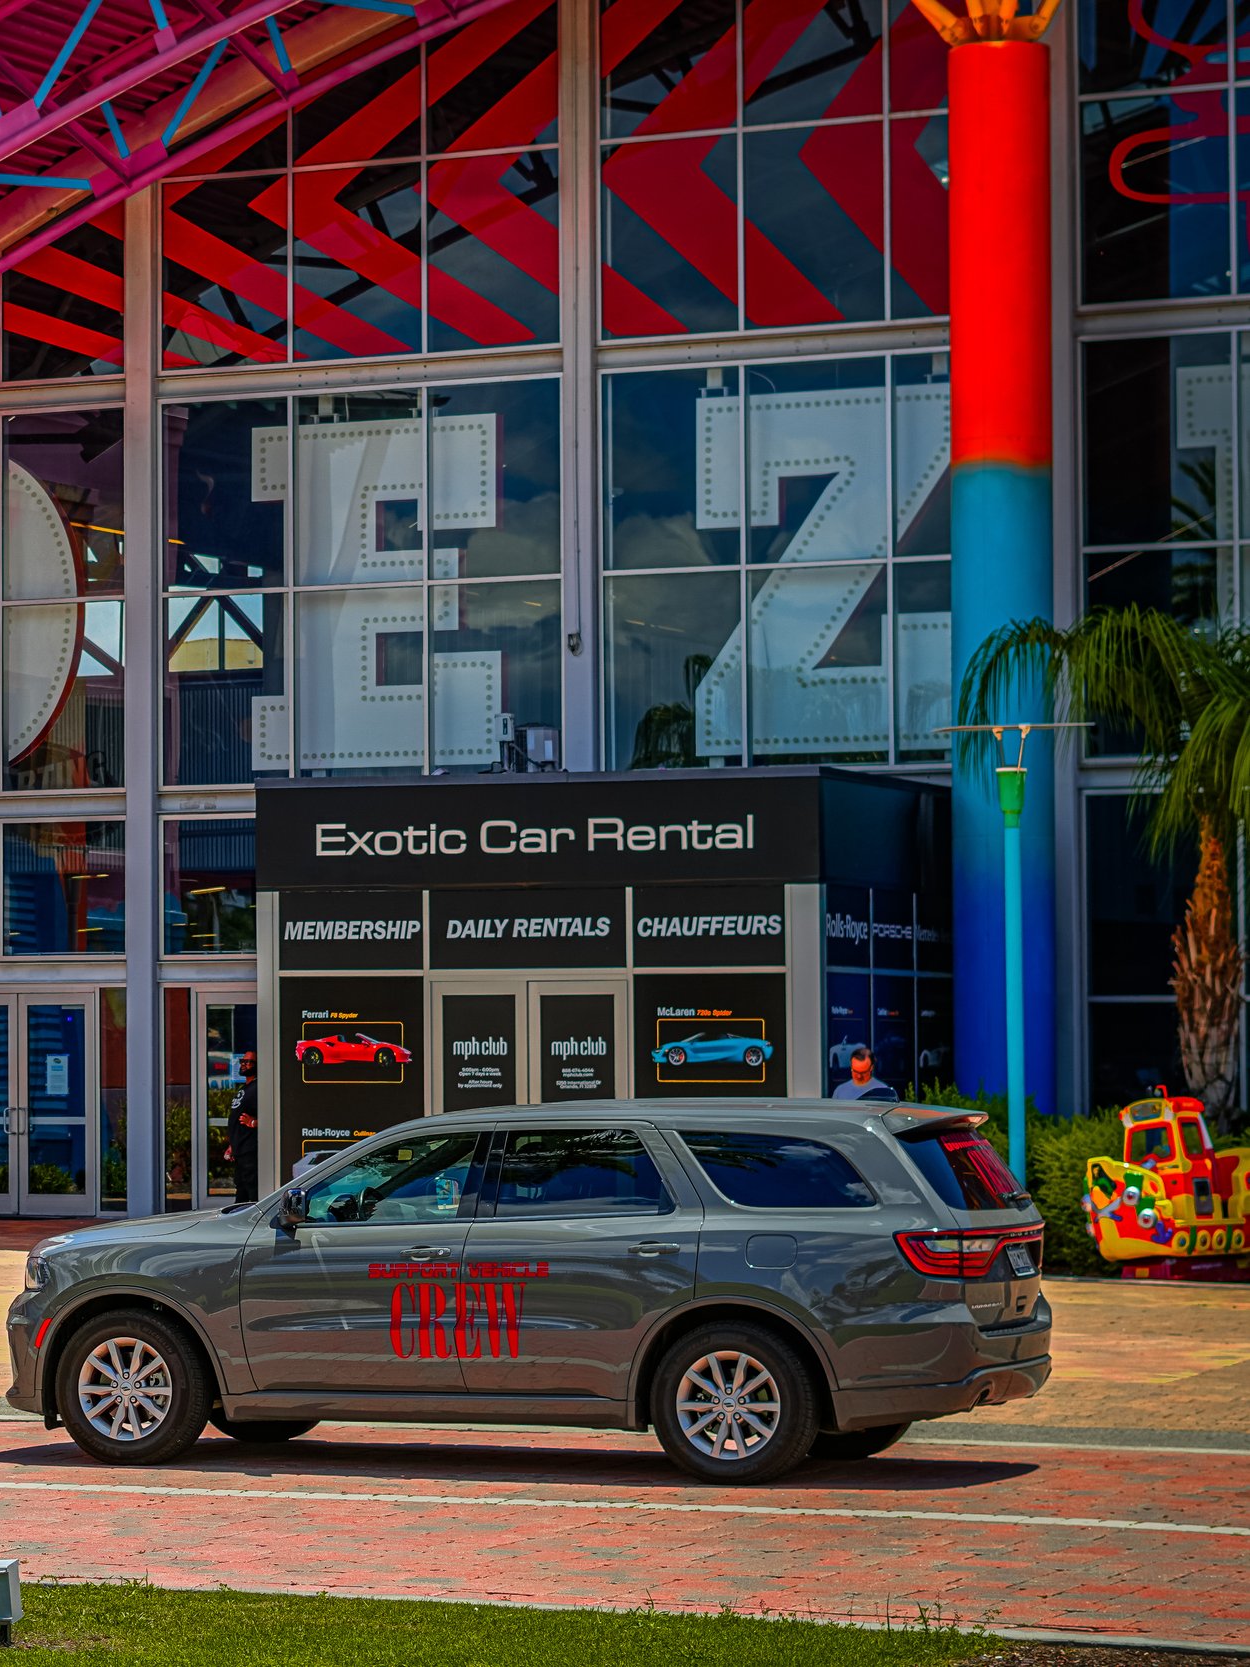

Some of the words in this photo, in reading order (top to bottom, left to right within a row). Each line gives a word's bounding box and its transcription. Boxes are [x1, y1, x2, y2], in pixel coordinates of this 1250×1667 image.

[315, 822, 468, 857] Exotic
[479, 820, 576, 854] Car
[587, 814, 755, 852] Rental
[284, 920, 421, 941] MEMBERSHIP
[446, 918, 509, 939] DAILY
[512, 916, 611, 938] RENTALS
[636, 914, 782, 938] CHAUFFEURS
[826, 913, 868, 945] Rolls-Royce
[872, 923, 912, 939] PORSCHE
[302, 1010, 329, 1019] Ferrari
[657, 1007, 695, 1017] McLaren
[453, 1036, 480, 1061] mph
[481, 1036, 508, 1056] club
[550, 1036, 578, 1061] mph
[580, 1036, 607, 1056] club
[302, 1128, 350, 1139] Rolls-Royce
[368, 1263, 460, 1279] SUPPORT
[467, 1262, 550, 1278] VEHICLE
[389, 1282, 527, 1359] CREW
